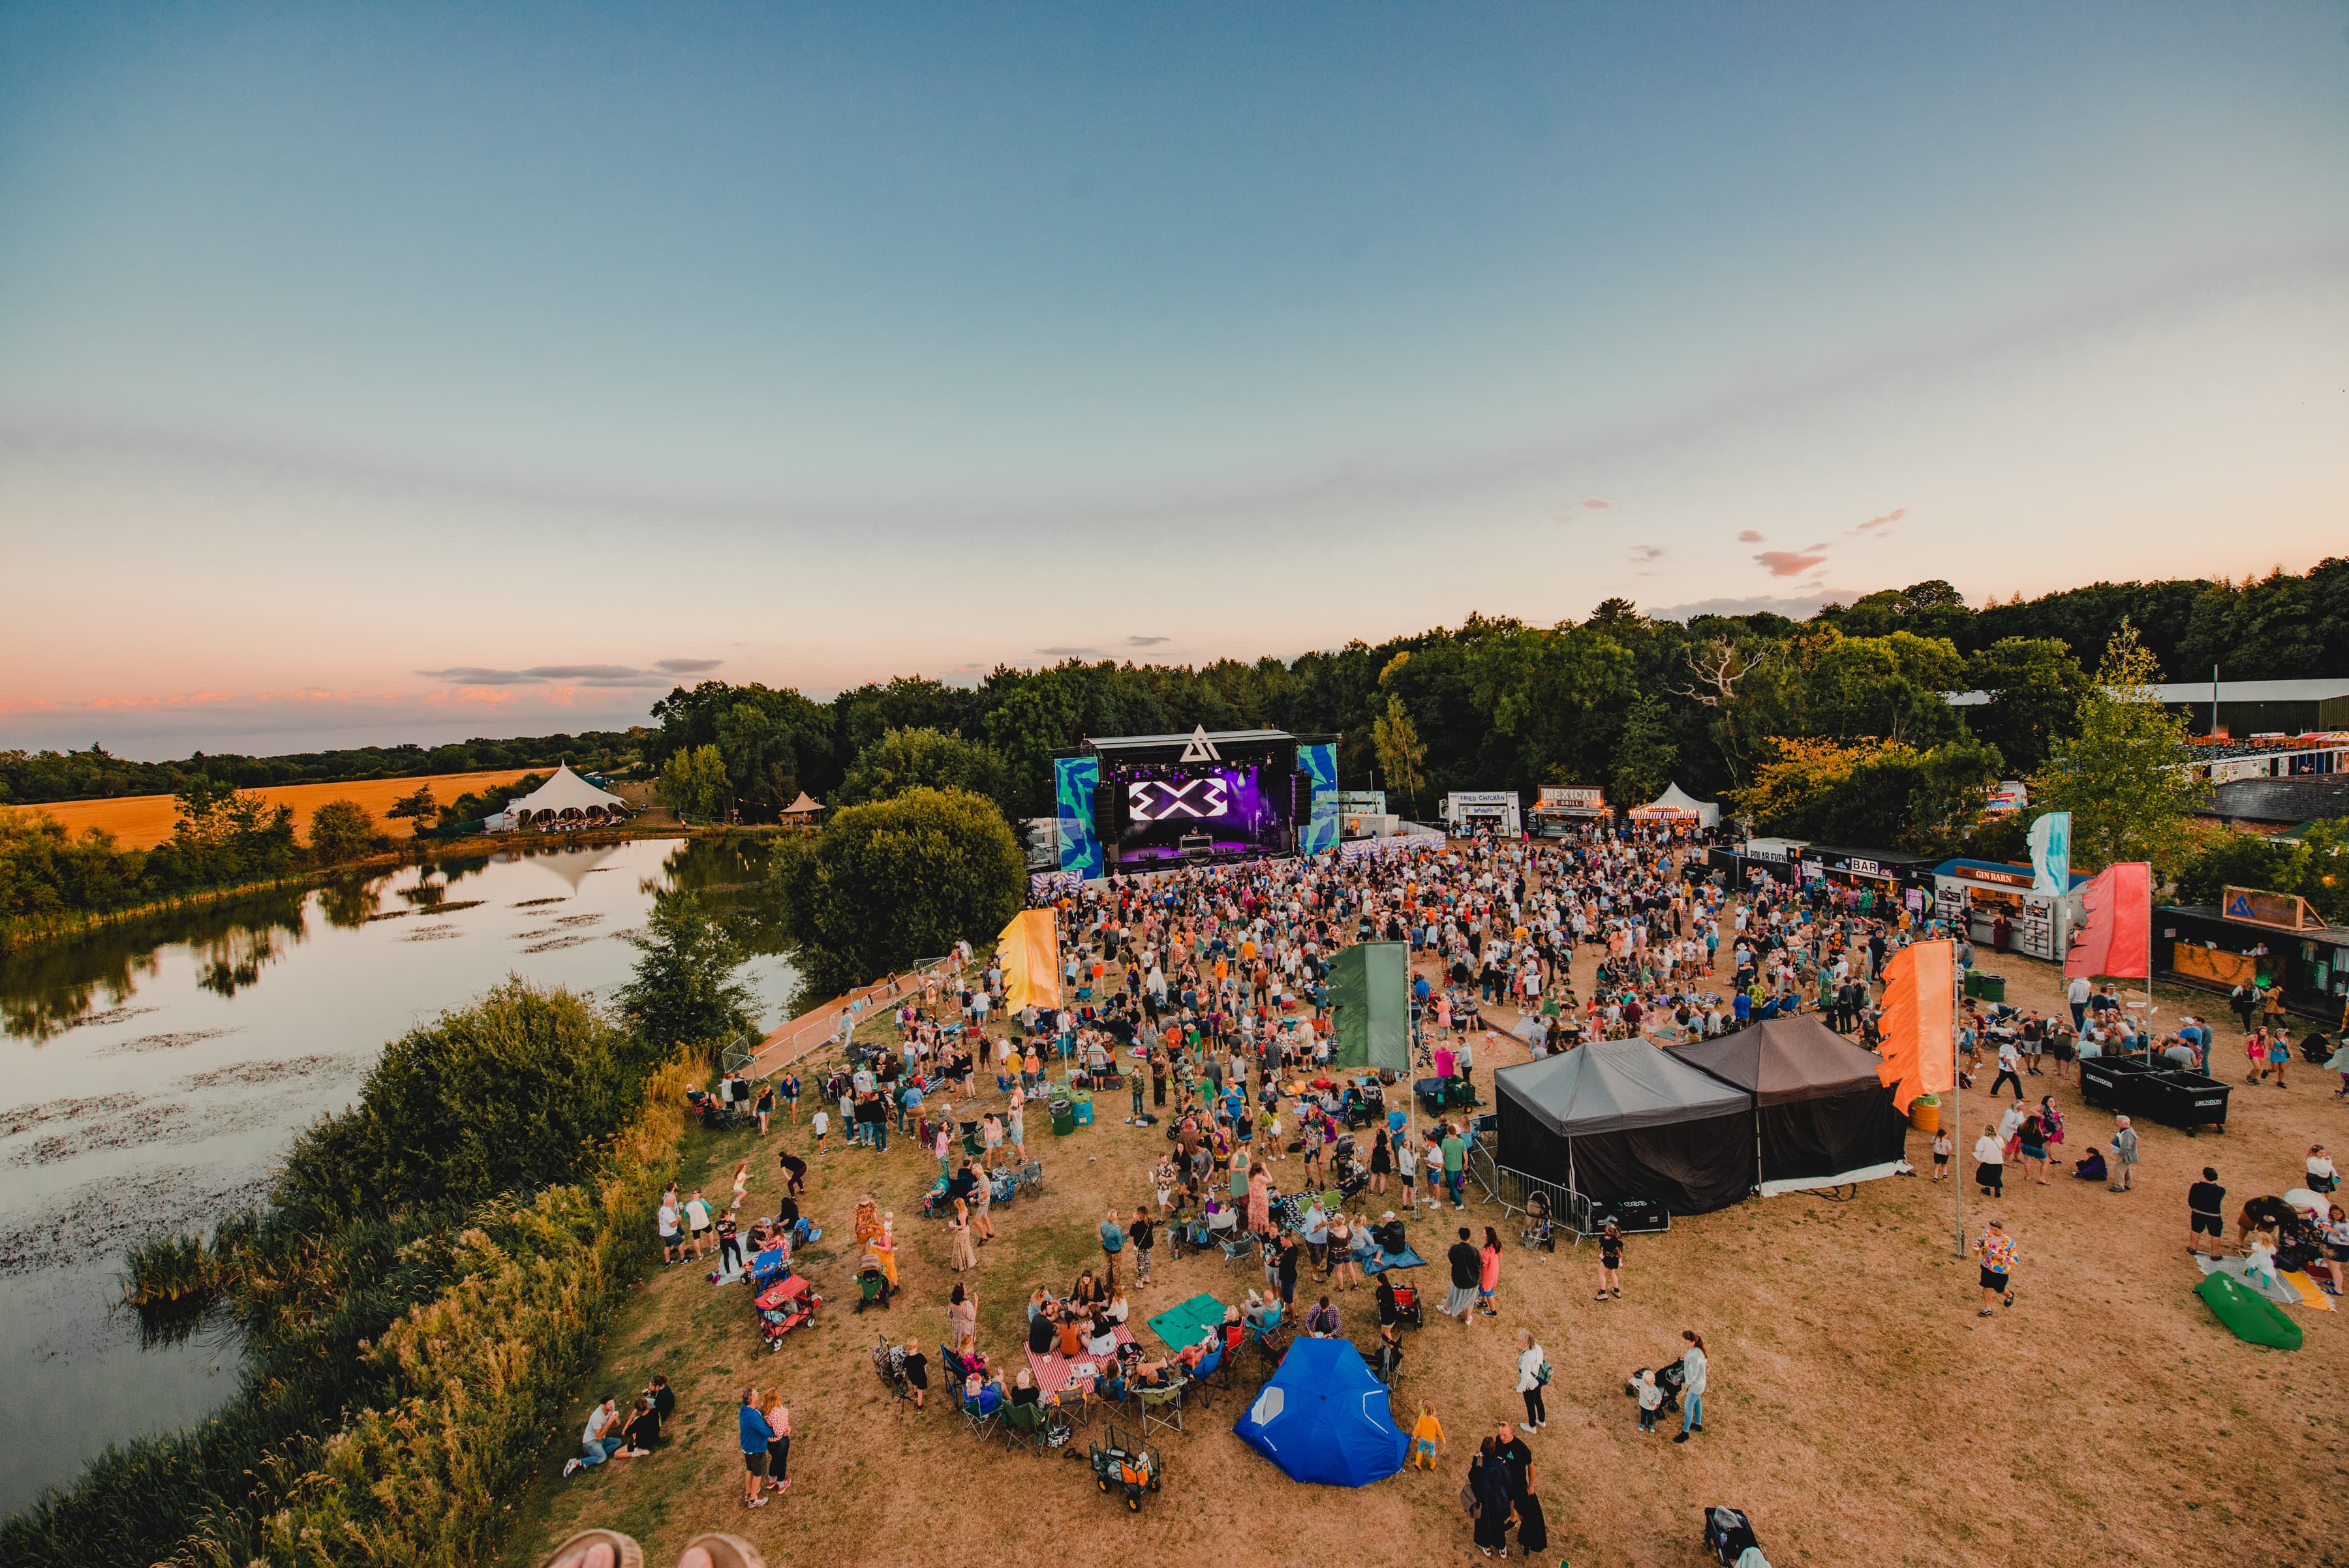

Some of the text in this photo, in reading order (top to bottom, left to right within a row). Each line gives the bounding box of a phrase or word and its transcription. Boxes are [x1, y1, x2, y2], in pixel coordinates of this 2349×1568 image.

[1543, 788, 1600, 801] MEXICAN
[1771, 853, 1787, 863] EVEN
[1853, 860, 1877, 872] BAR
[1976, 870, 1989, 880] GIN
[1991, 872, 2012, 883] BARN
[2087, 1073, 2113, 1088] GRUNDON
